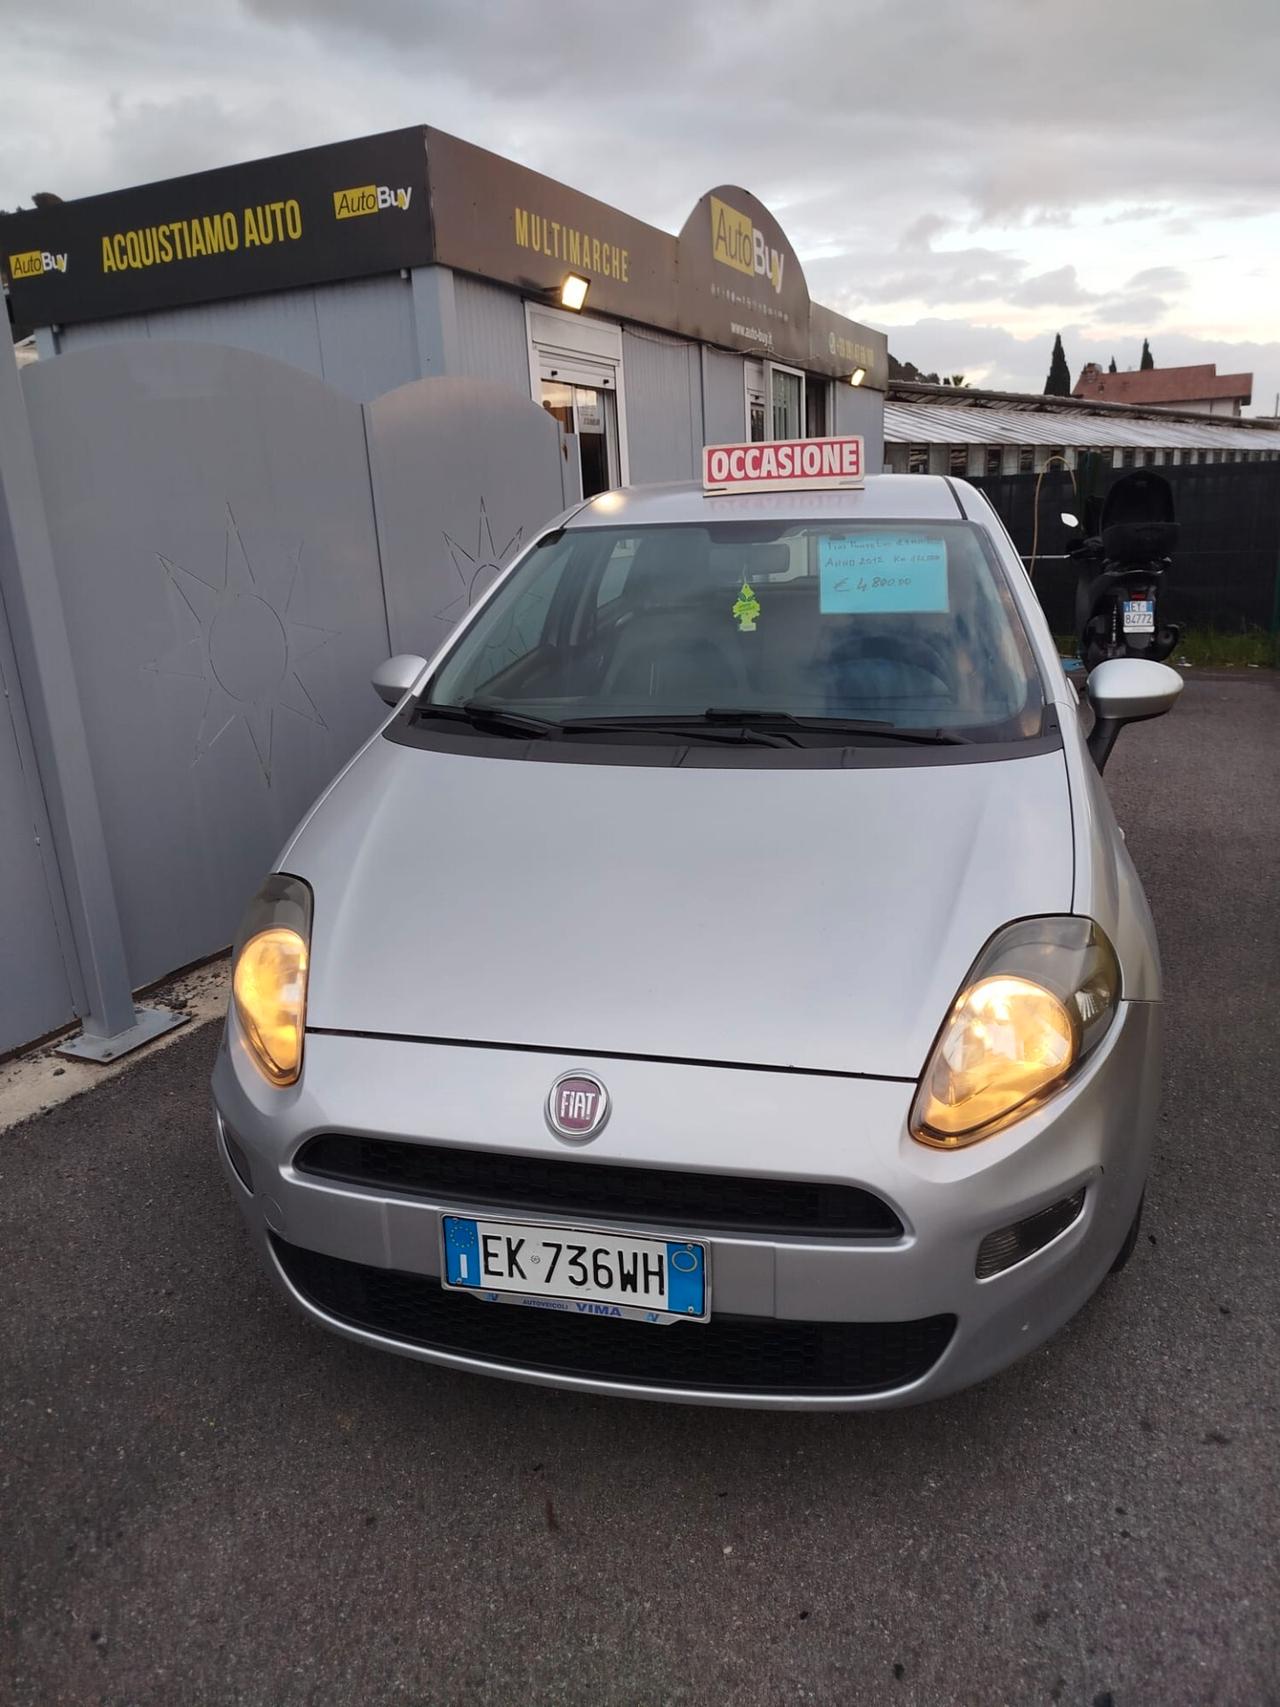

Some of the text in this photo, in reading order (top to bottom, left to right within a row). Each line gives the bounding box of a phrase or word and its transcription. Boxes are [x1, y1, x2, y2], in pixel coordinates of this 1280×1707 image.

[335, 185, 412, 219] AutoBuy
[101, 199, 302, 273] ACQUISTIAMO AUTO
[514, 207, 630, 283] MULTIMARCHE
[713, 203, 784, 294] AutoBuy
[11, 250, 68, 277] AutoBuy
[710, 442, 858, 481] OCCASIONE
[560, 1090, 595, 1119] FIAT
[481, 1234, 527, 1280] EK
[542, 1242, 665, 1296] 736WH
[521, 1298, 622, 1317] AUTOVEICOLI VIMA
